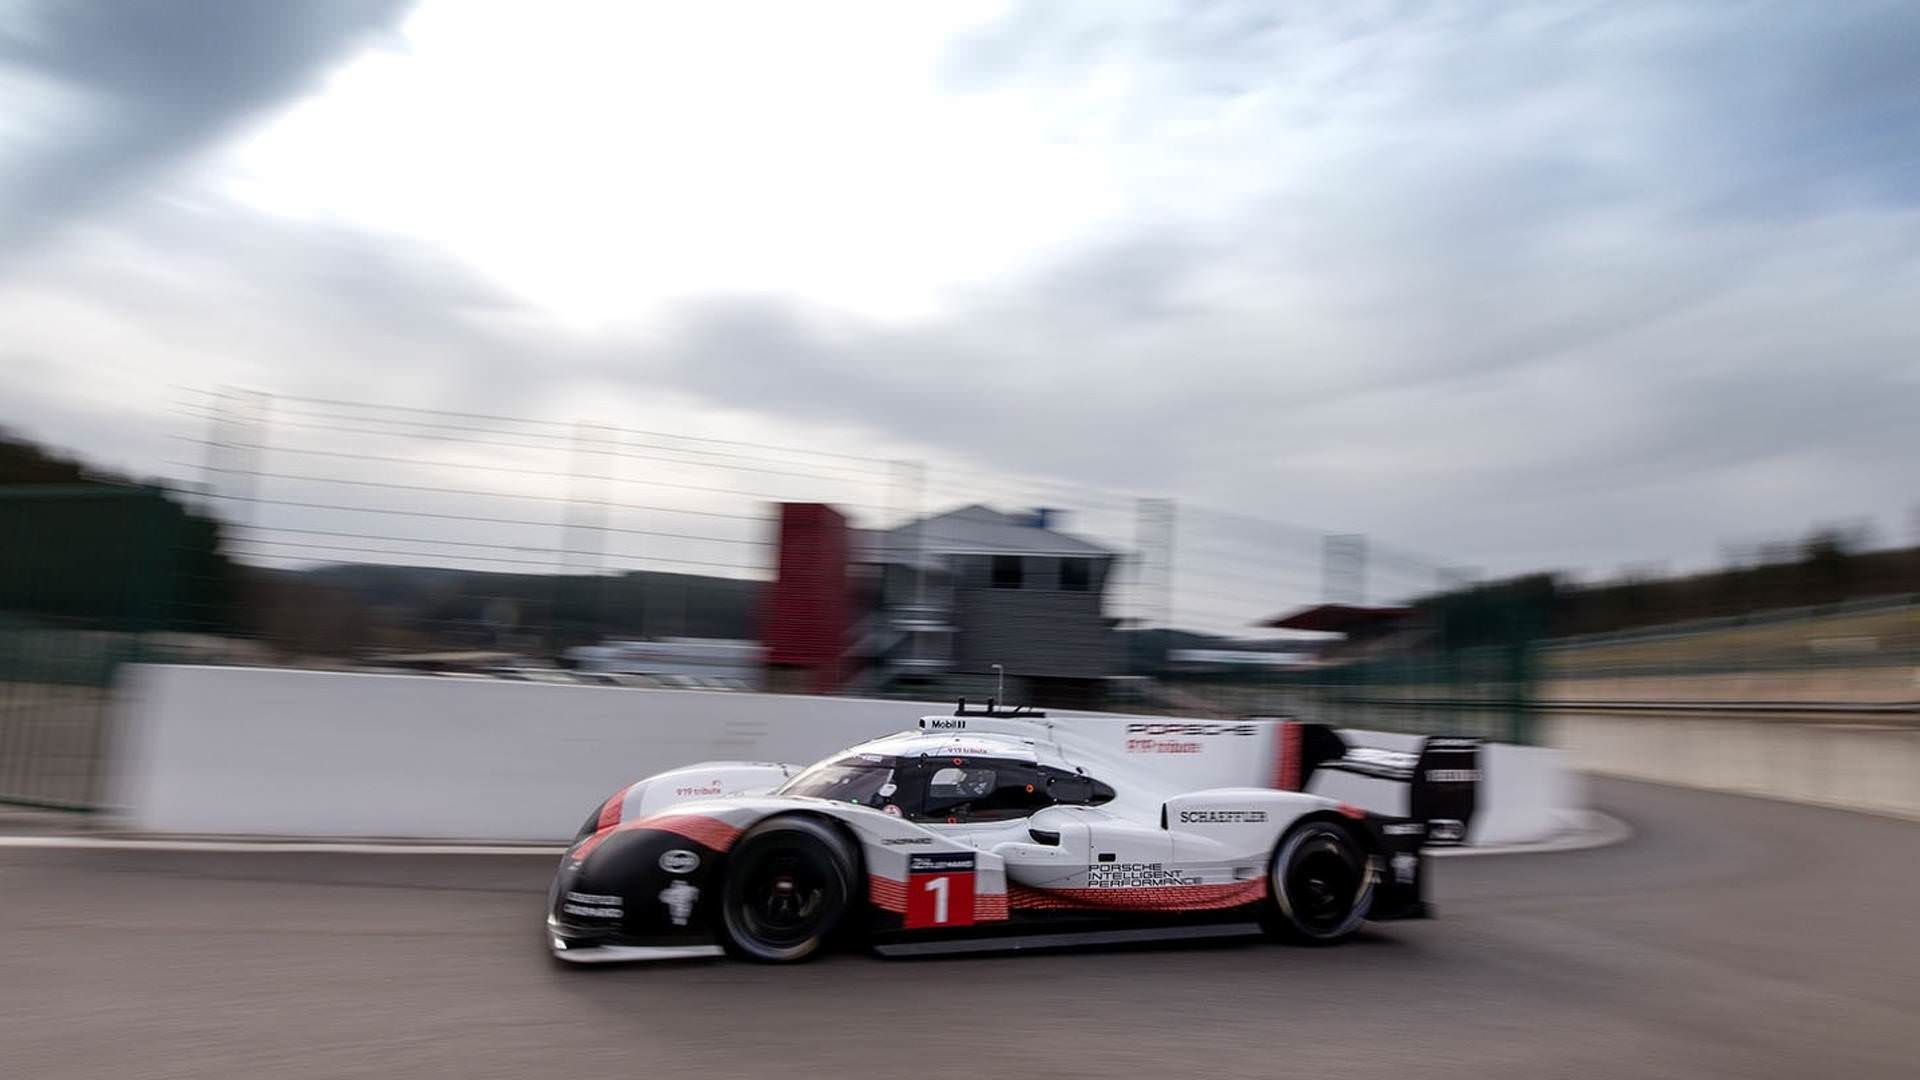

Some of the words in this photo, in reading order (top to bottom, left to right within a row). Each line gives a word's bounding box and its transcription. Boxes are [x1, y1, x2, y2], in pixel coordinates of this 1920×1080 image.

[1128, 723, 1257, 736] PORSCHE
[1180, 811, 1268, 823] SCHAEFFLER
[1088, 863, 1162, 872] PORSCHE
[1088, 870, 1183, 880] INTELLIGENT
[1088, 877, 1202, 887] PERFORMANCE
[924, 876, 949, 923] 1
